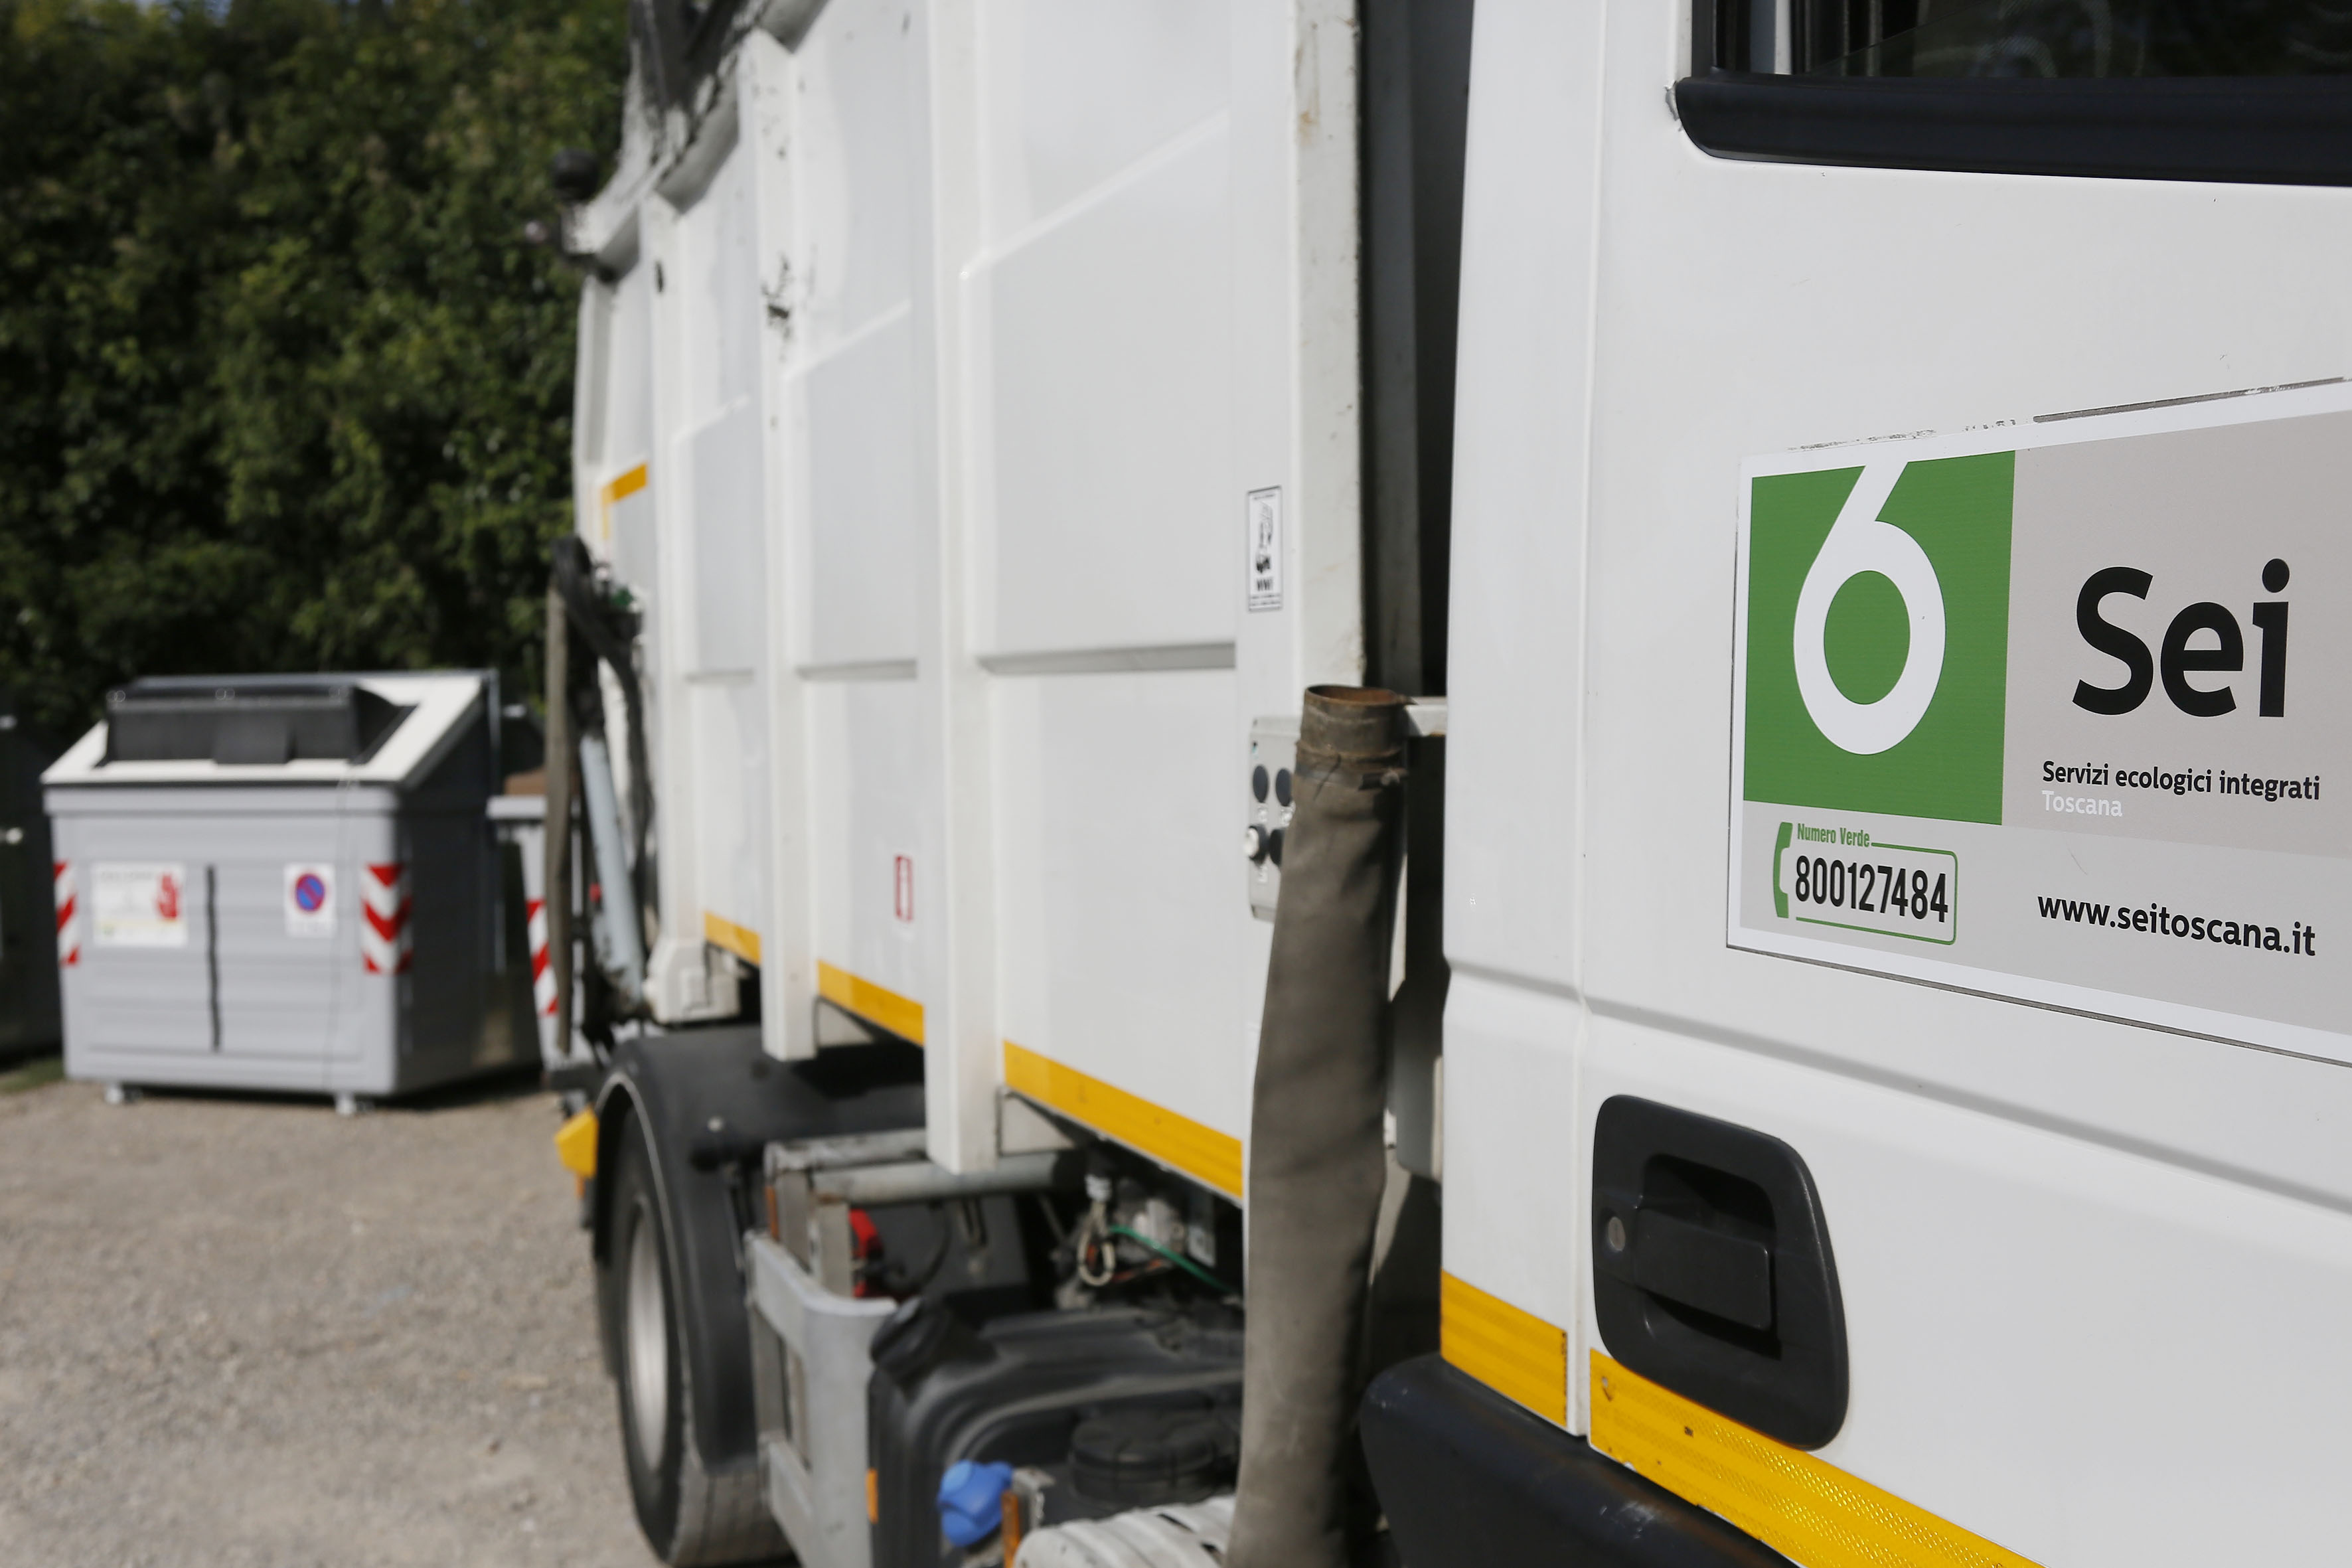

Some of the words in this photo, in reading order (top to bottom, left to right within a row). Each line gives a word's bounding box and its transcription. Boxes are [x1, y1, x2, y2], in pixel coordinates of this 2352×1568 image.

[2073, 558, 2290, 717] Sei
[2042, 790, 2123, 817] Toscana
[2043, 761, 2108, 785] Servizi
[2116, 767, 2211, 795] ecologici
[2220, 770, 2319, 802] integrati
[1797, 823, 1836, 844] Numero
[1840, 827, 1870, 847] Verde
[1795, 855, 1949, 923] 800127484
[2038, 897, 2315, 956] www.seitoscana.it
